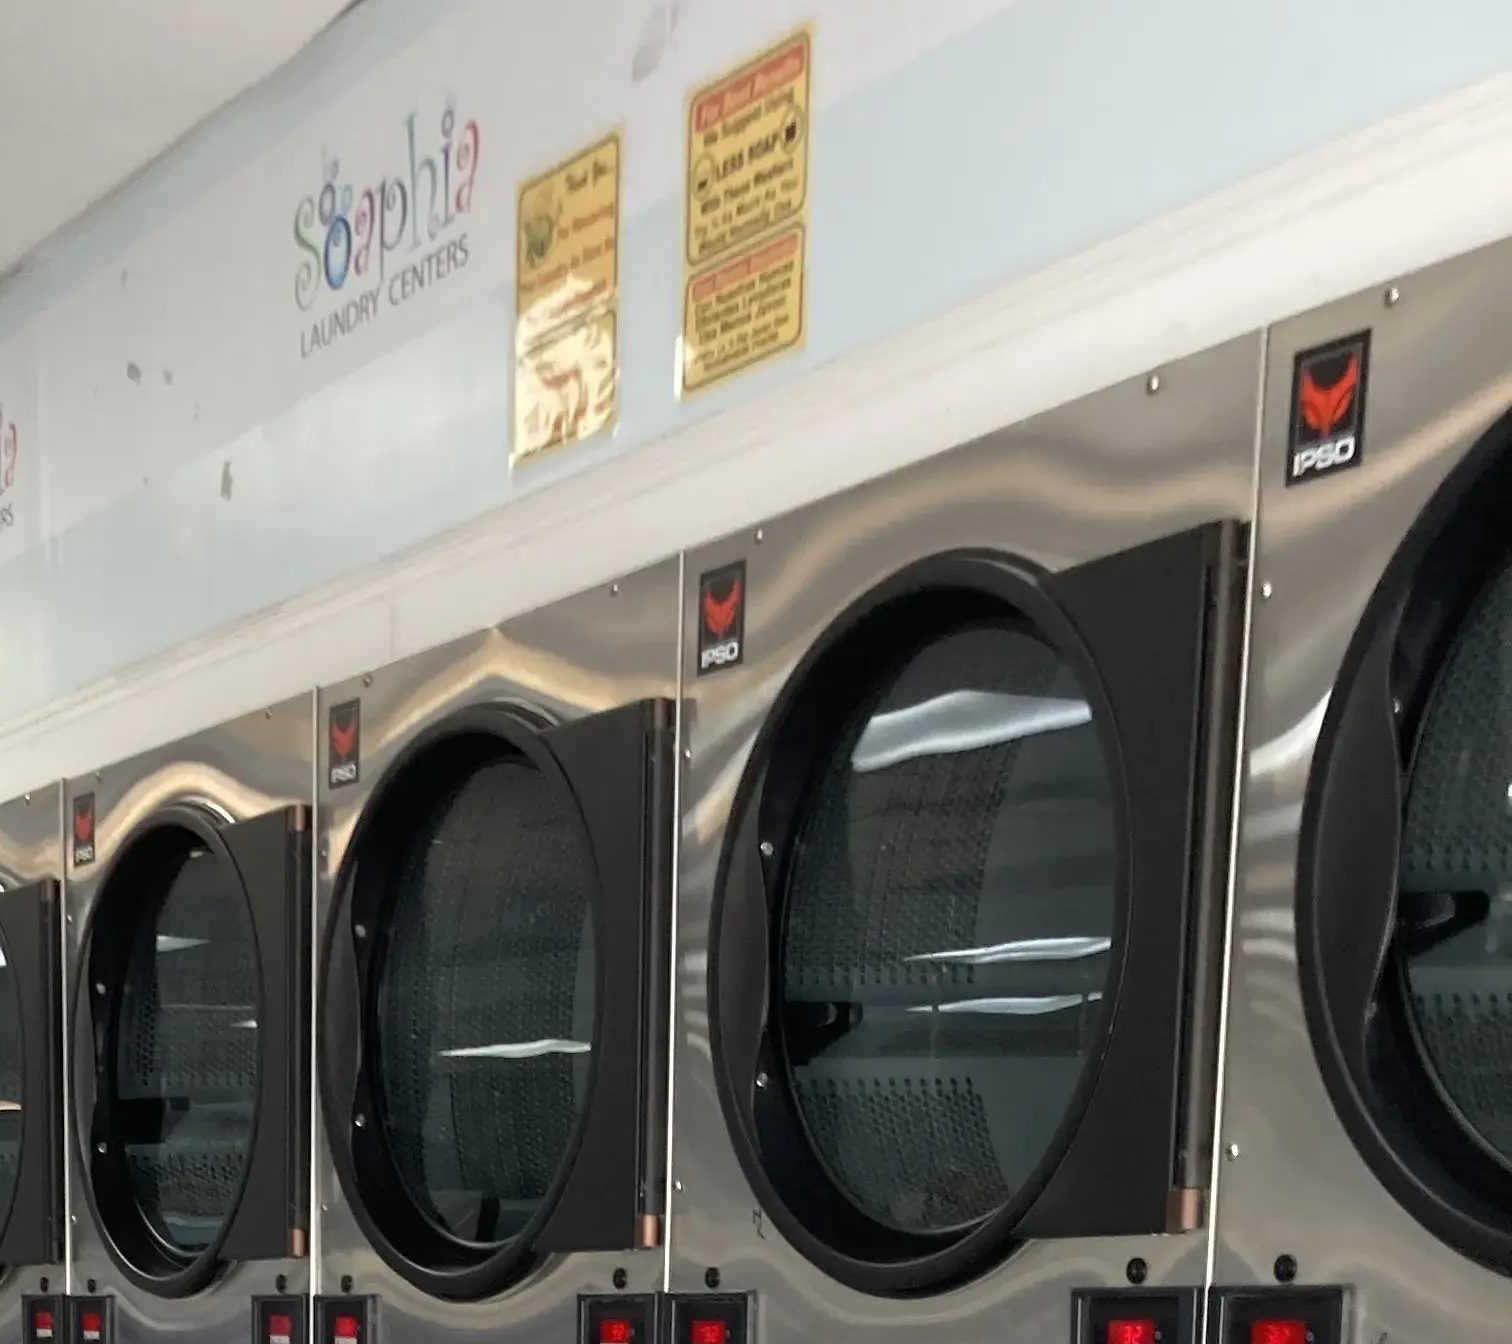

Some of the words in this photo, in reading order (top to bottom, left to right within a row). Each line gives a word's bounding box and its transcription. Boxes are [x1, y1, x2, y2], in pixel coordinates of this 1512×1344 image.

[300, 286, 381, 359] LAUNDRY
[388, 232, 472, 307] CENTERS
[1292, 436, 1356, 478] IPSO
[701, 641, 739, 669] IPSO
